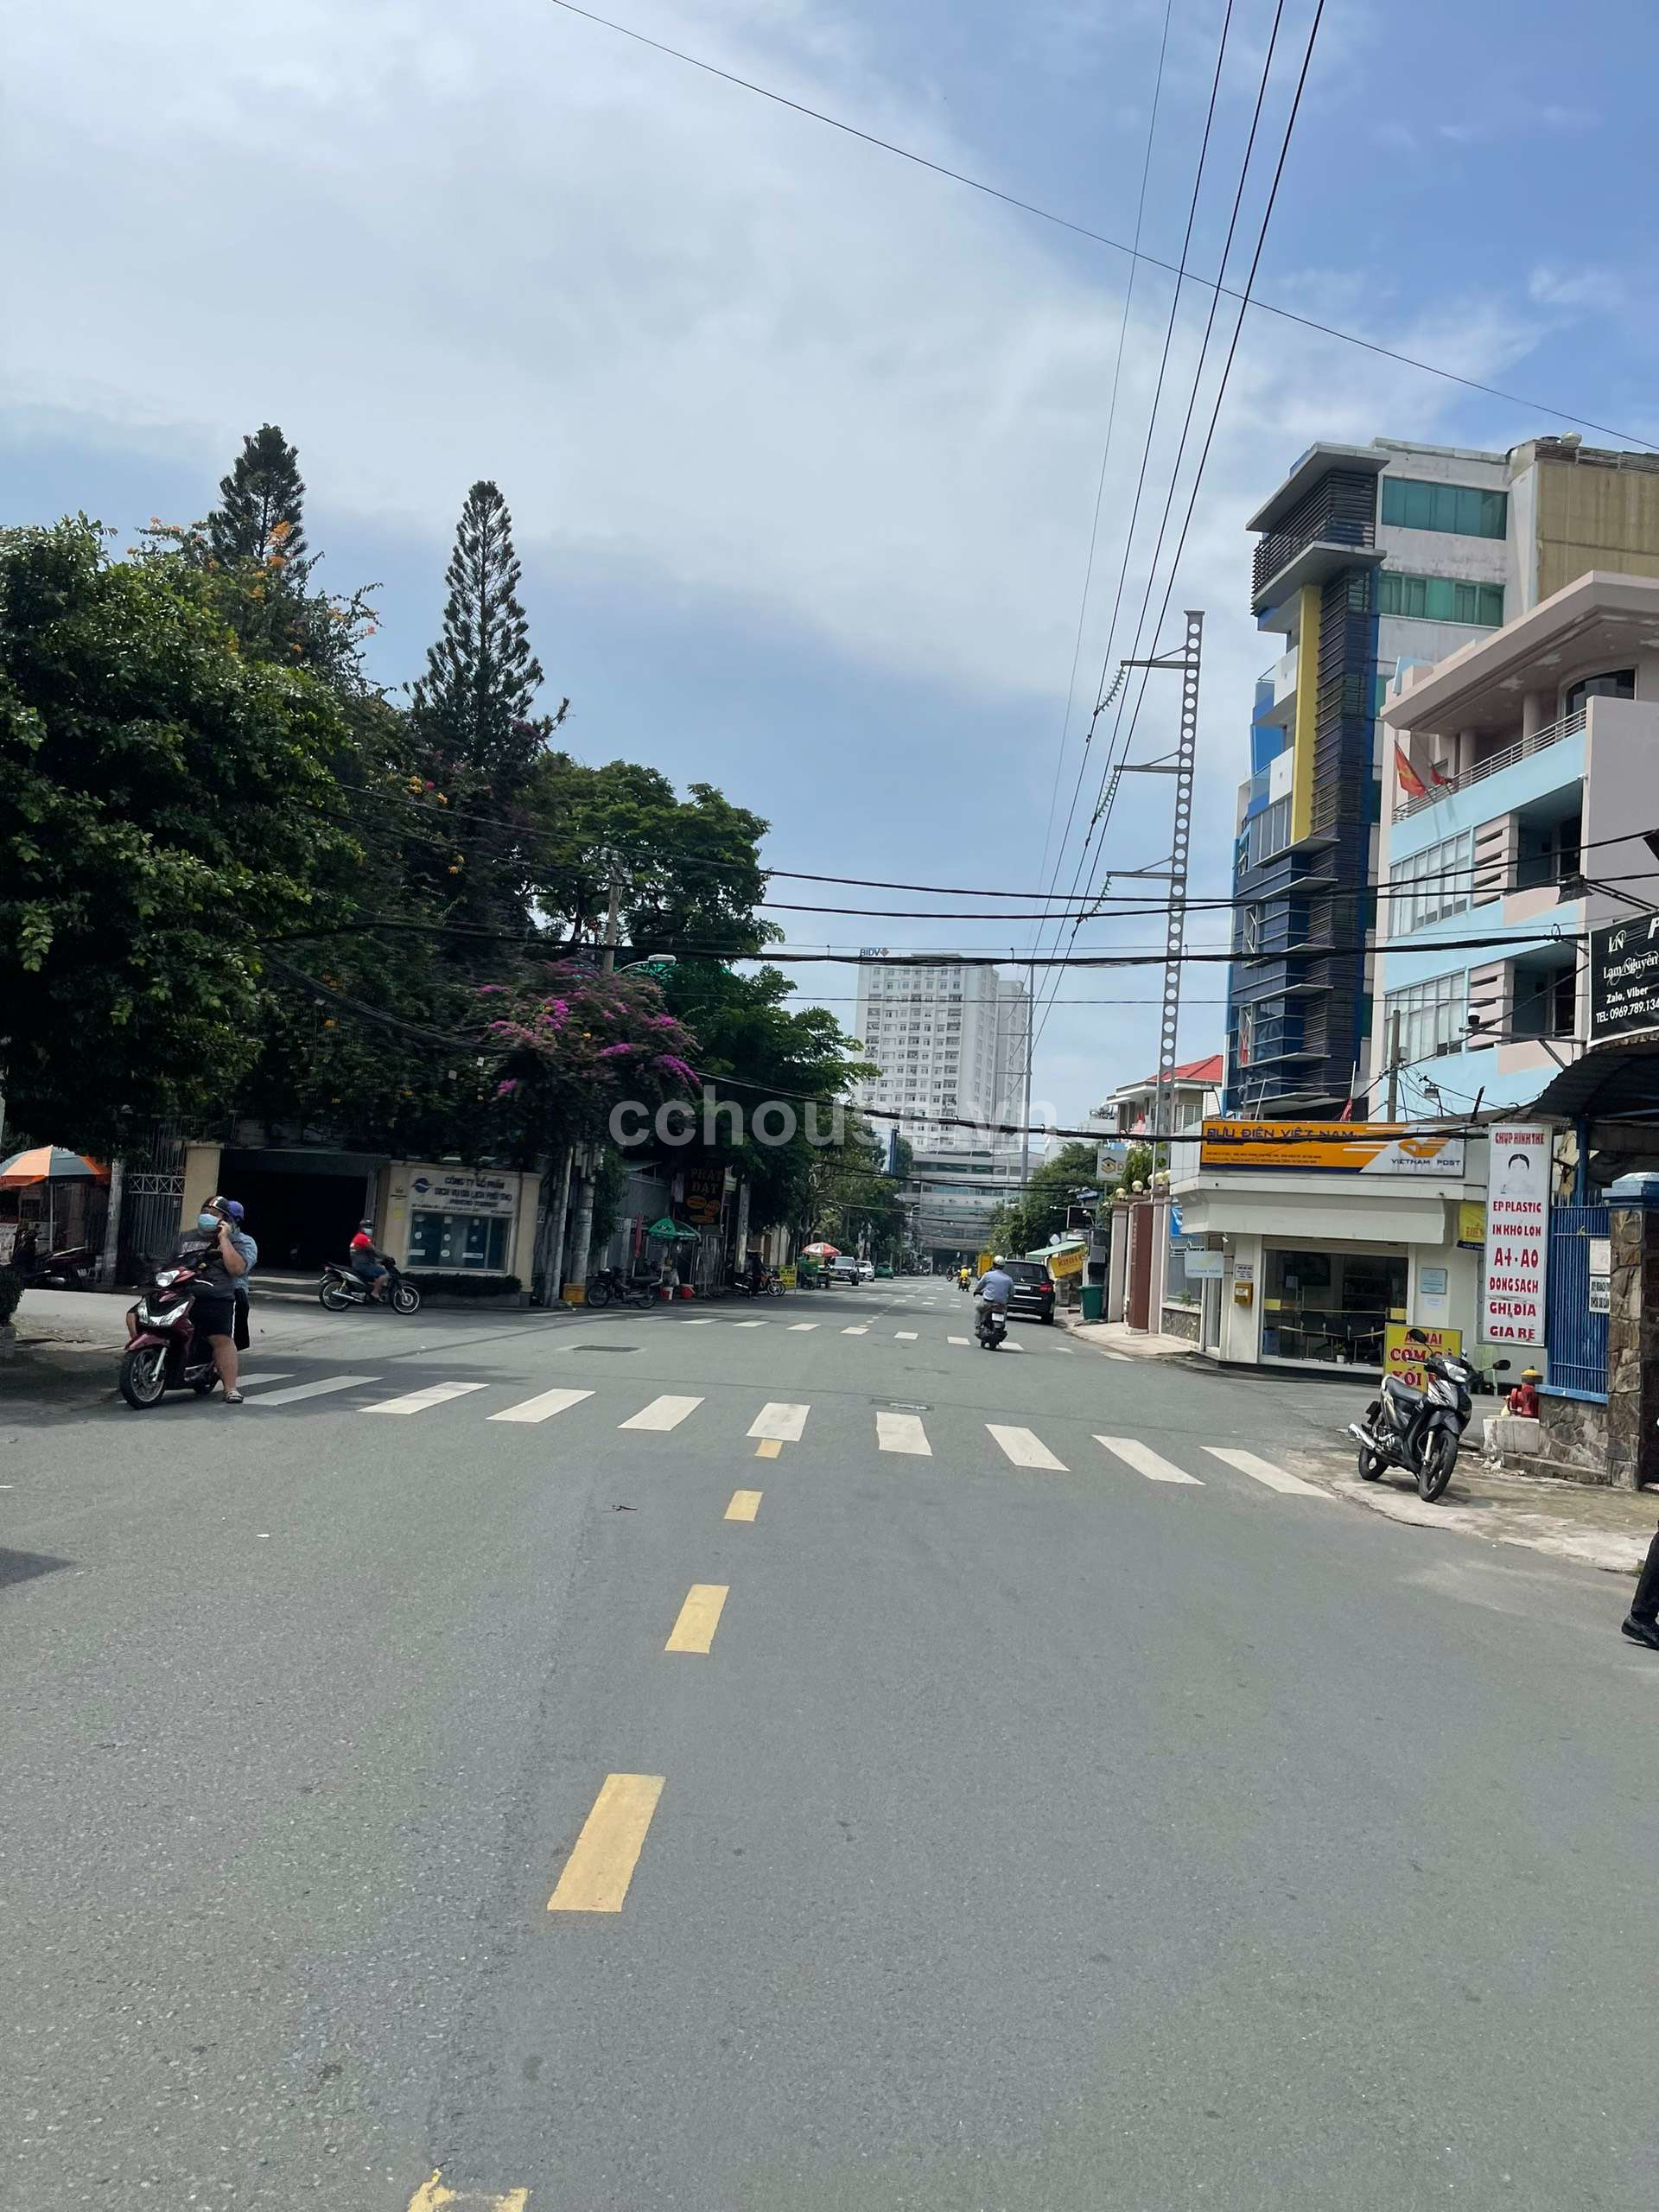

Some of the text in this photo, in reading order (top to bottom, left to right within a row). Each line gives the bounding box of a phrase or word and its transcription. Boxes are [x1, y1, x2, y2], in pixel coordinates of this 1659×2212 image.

[860, 948, 880, 957] BIDV
[1606, 991, 1625, 1004] Zalo,
[1505, 1201, 1541, 1213] PLASTIC
